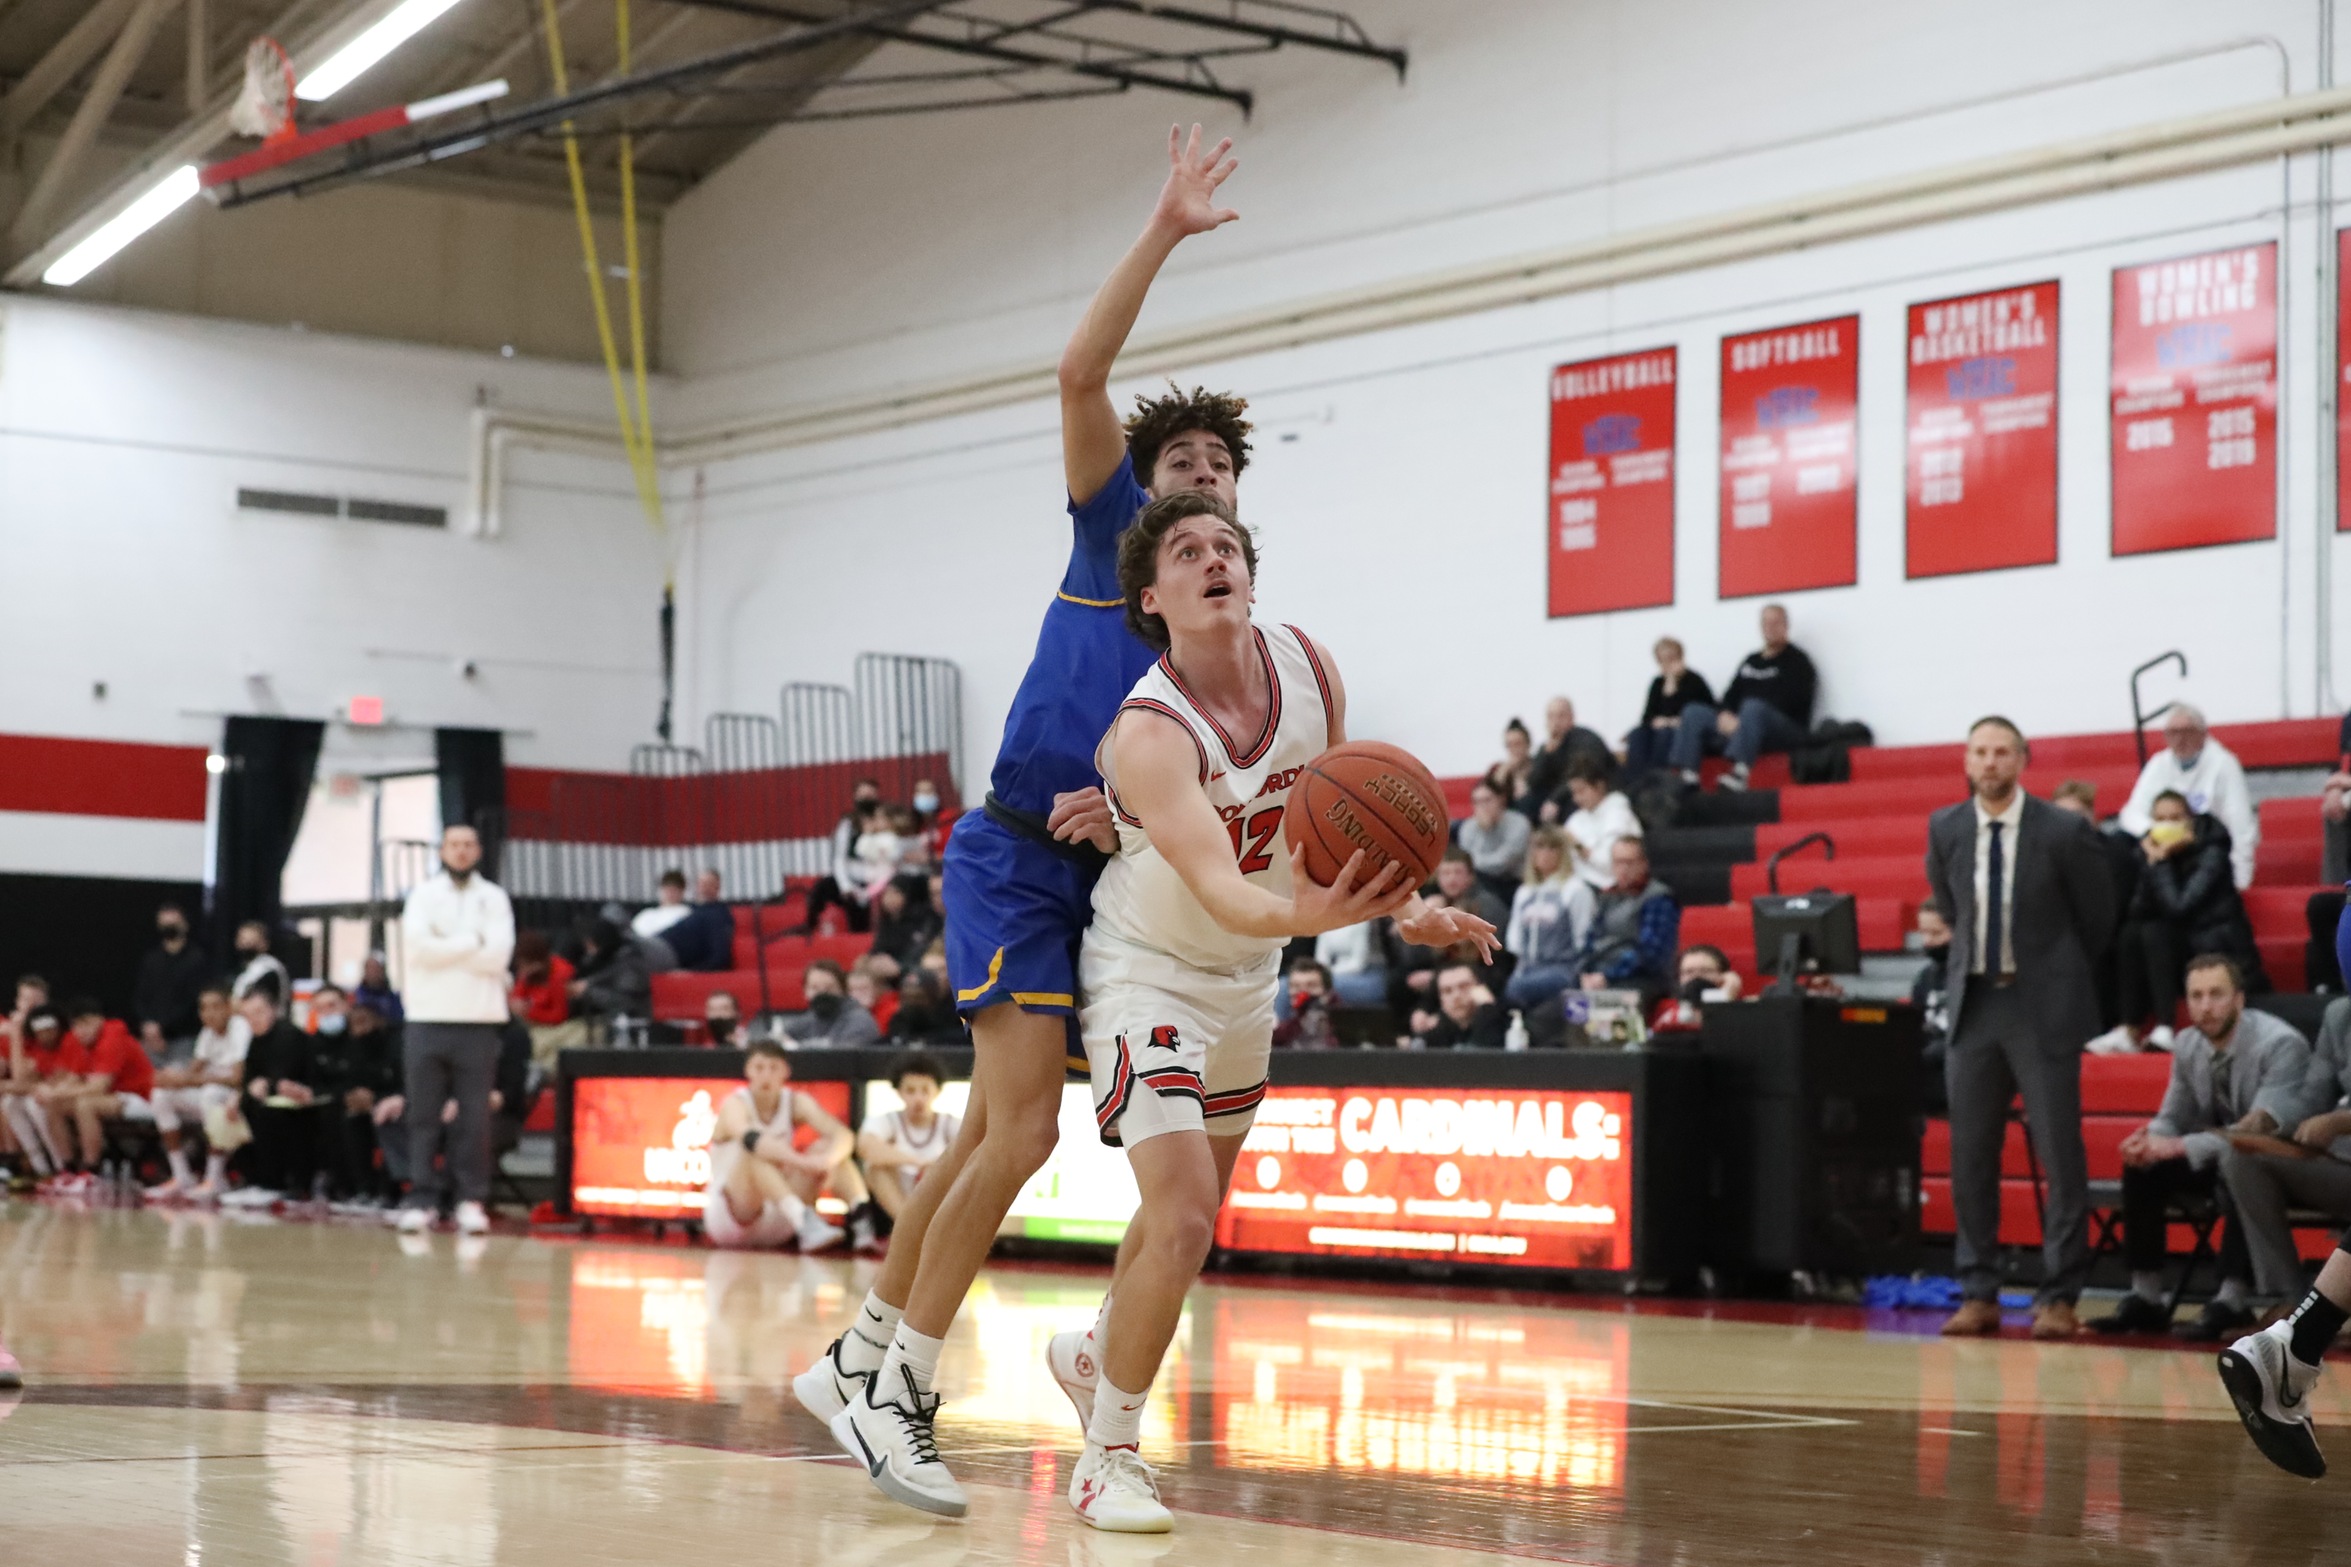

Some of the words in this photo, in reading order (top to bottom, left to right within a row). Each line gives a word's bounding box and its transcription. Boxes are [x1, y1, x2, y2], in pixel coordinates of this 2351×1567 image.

[1552, 356, 1674, 401] VOLLEYBALL
[1731, 328, 1840, 372] SOFTBALL
[1226, 804, 1285, 875] 12
[1362, 778, 1437, 848] LEGACY
